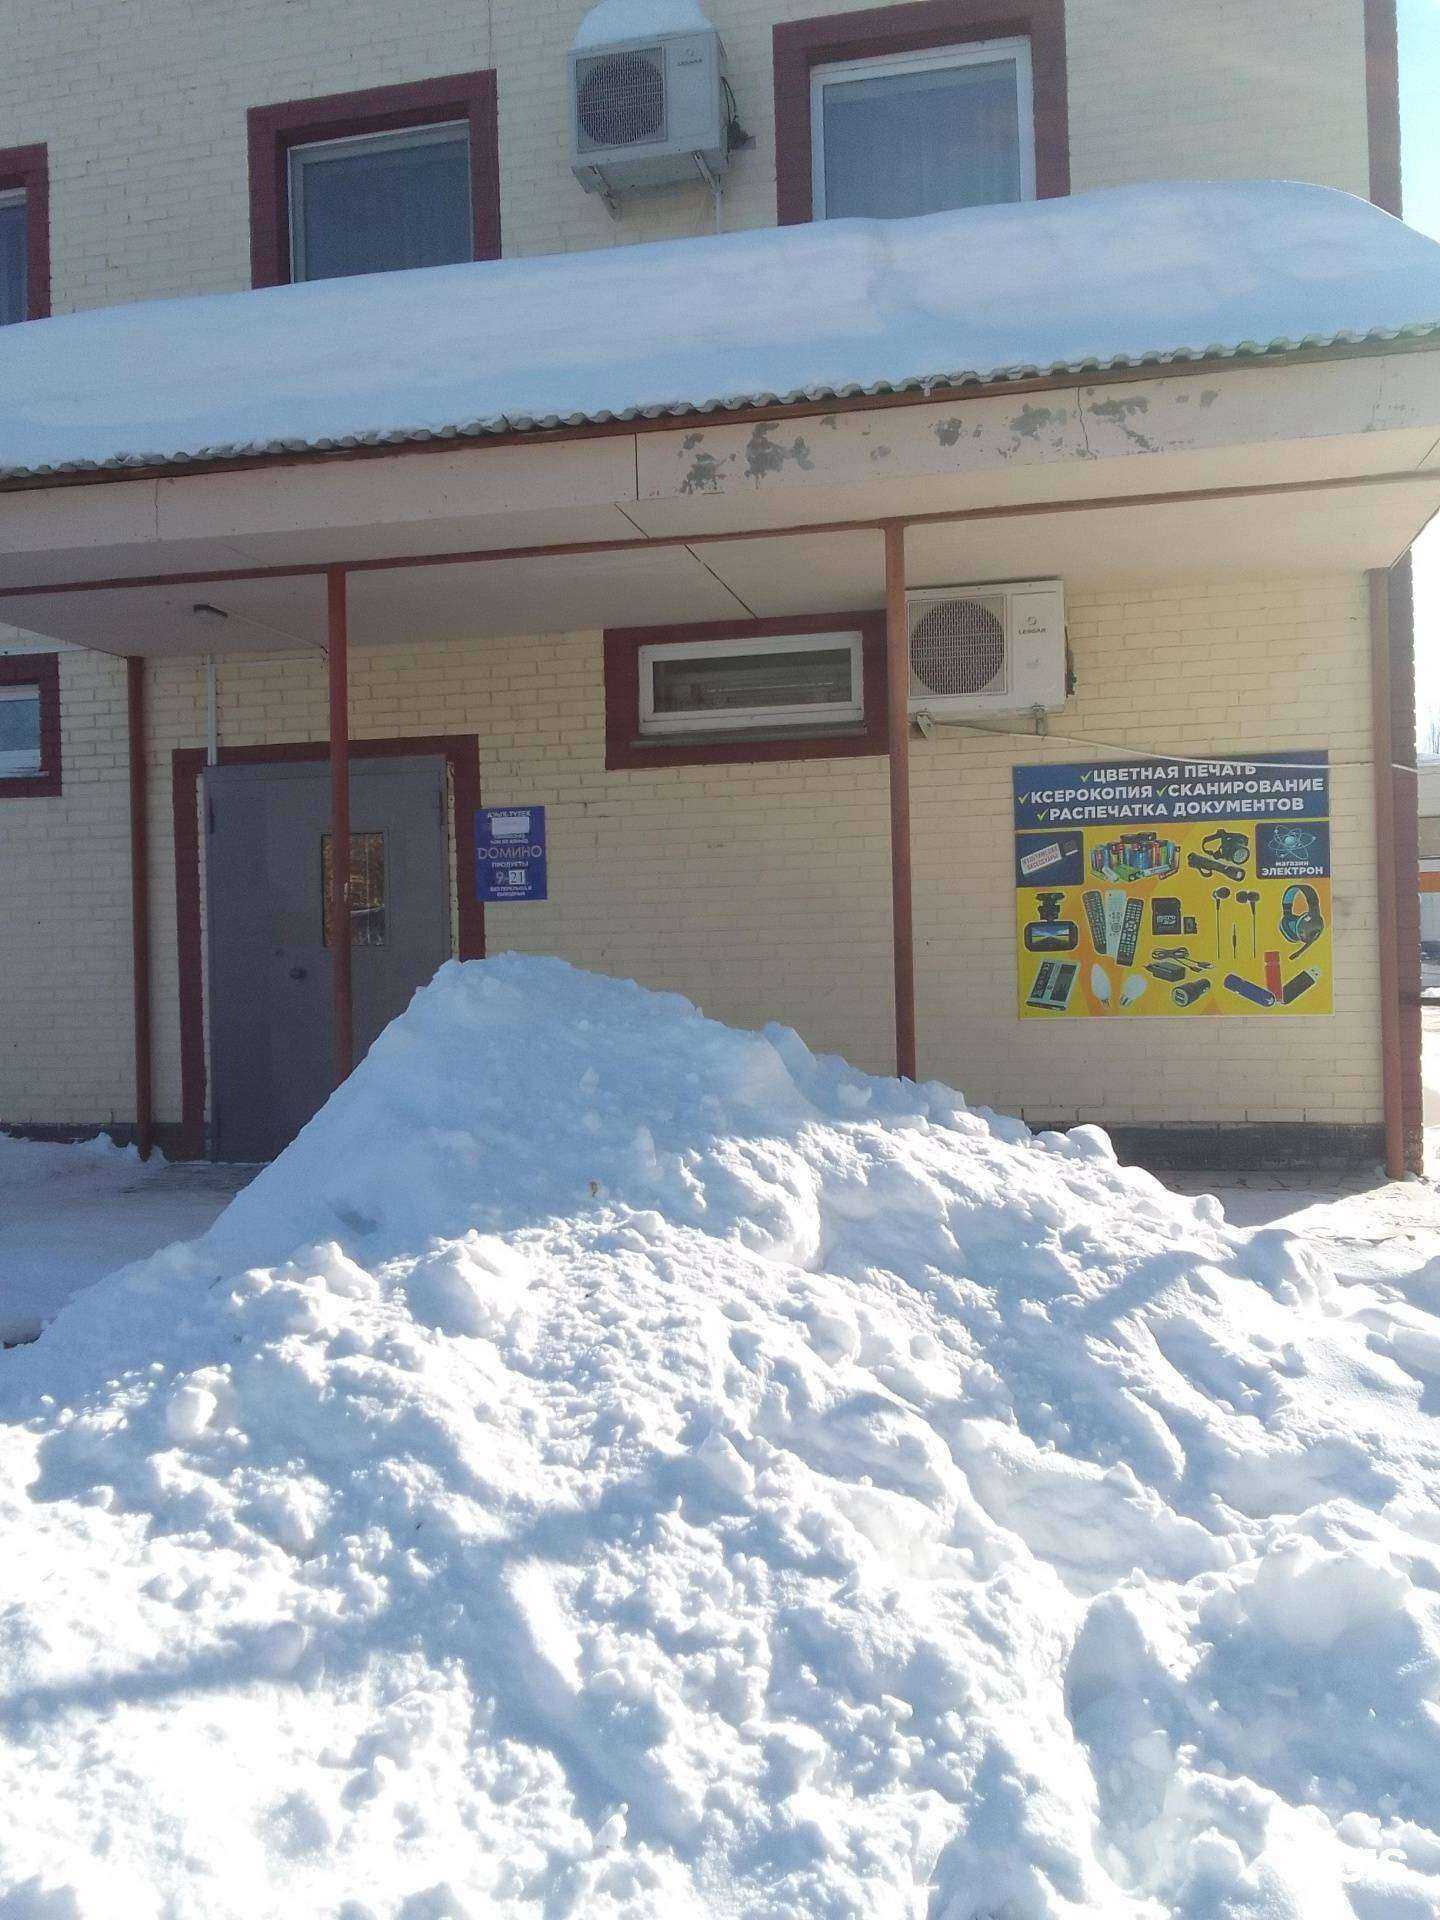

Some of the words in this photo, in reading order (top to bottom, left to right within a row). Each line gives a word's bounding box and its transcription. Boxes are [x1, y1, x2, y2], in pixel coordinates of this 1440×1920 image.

[1093, 765, 1178, 784] ЦВЕТНАЯ
[1184, 763, 1256, 778] ПЕЧАТЬ
[1031, 785, 1152, 804] КСЕРОКОПИЯ
[1167, 778, 1324, 797] СКАНИРОВАНИЕ
[1049, 803, 1168, 821] РАСПЕЧАТКА
[1173, 797, 1304, 817] ДОКУМЕНТОВ
[1261, 866, 1324, 876] ЭЛЕКТРОН
